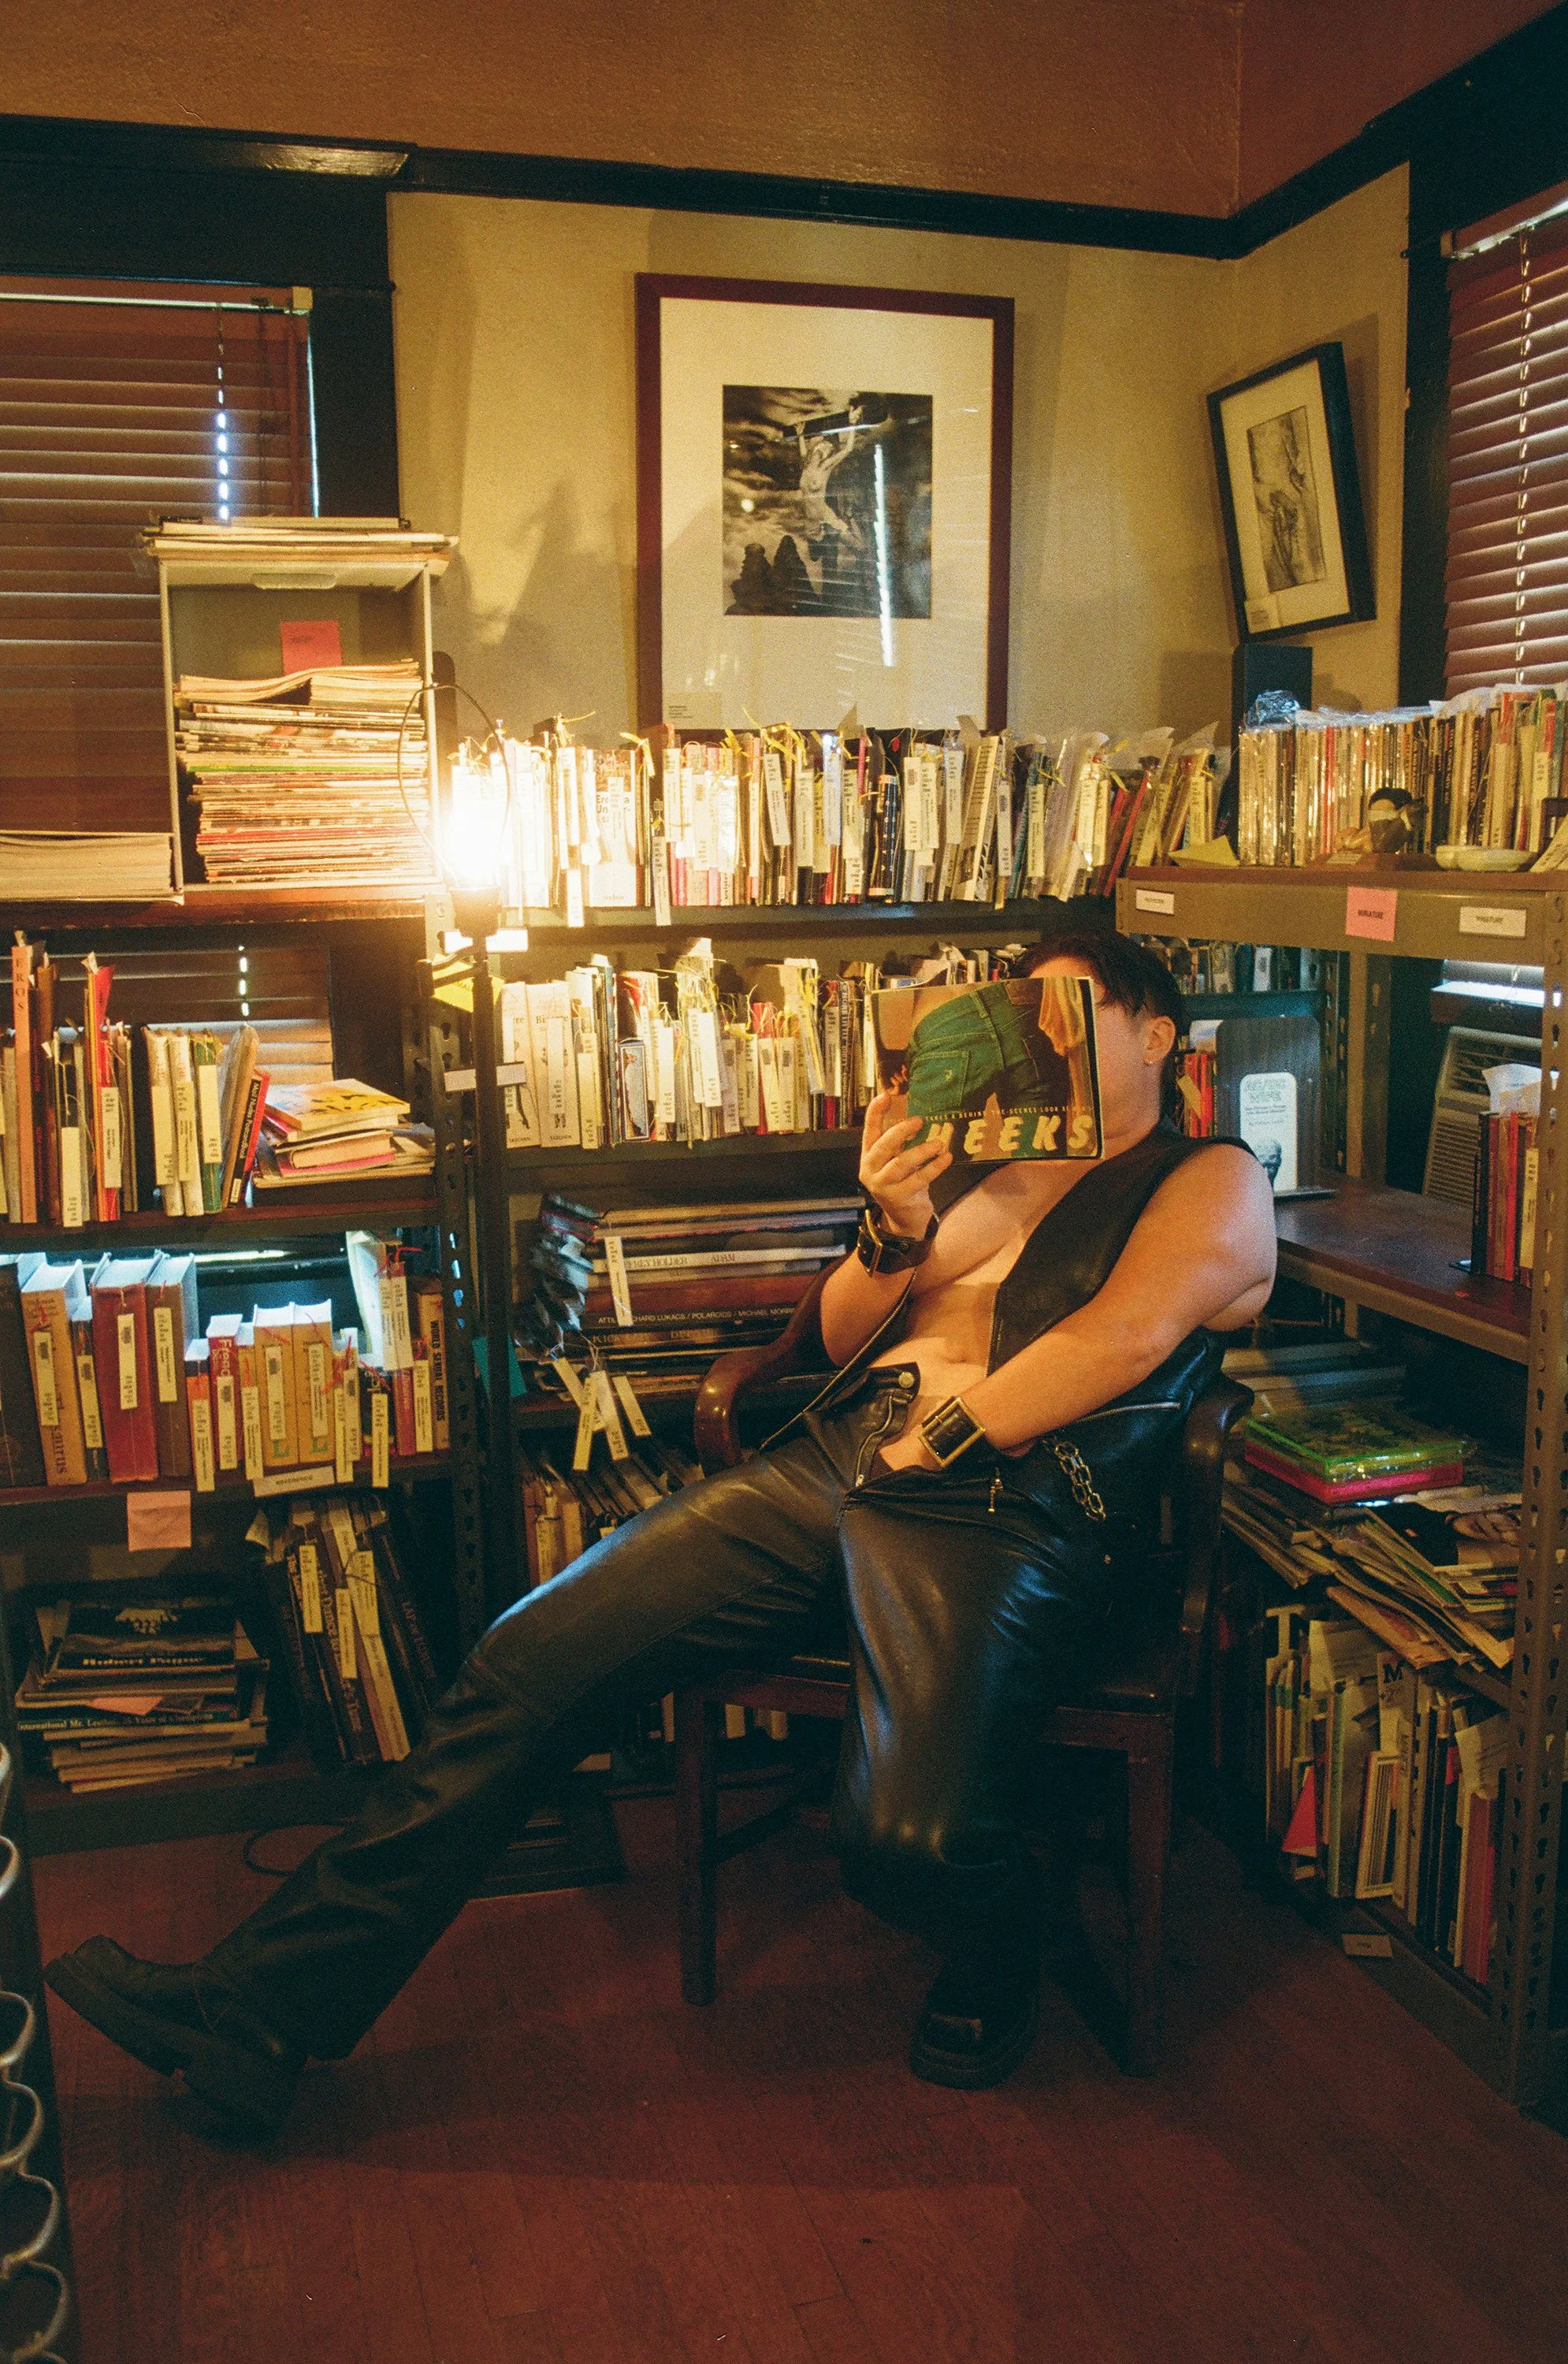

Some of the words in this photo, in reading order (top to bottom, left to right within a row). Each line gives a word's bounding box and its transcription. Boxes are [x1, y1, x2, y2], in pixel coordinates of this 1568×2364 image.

[14, 958, 28, 1012] EROS
[653, 1255, 688, 1268] HOLDER
[712, 1253, 736, 1263] ADAM
[597, 1316, 619, 1325] ATTIL
[631, 1314, 655, 1324] CHARD
[738, 1308, 769, 1319] MICHAEL
[430, 1321, 440, 1350] WORLD
[433, 1352, 443, 1382] SEXUAL
[435, 1385, 445, 1422] RECORDS
